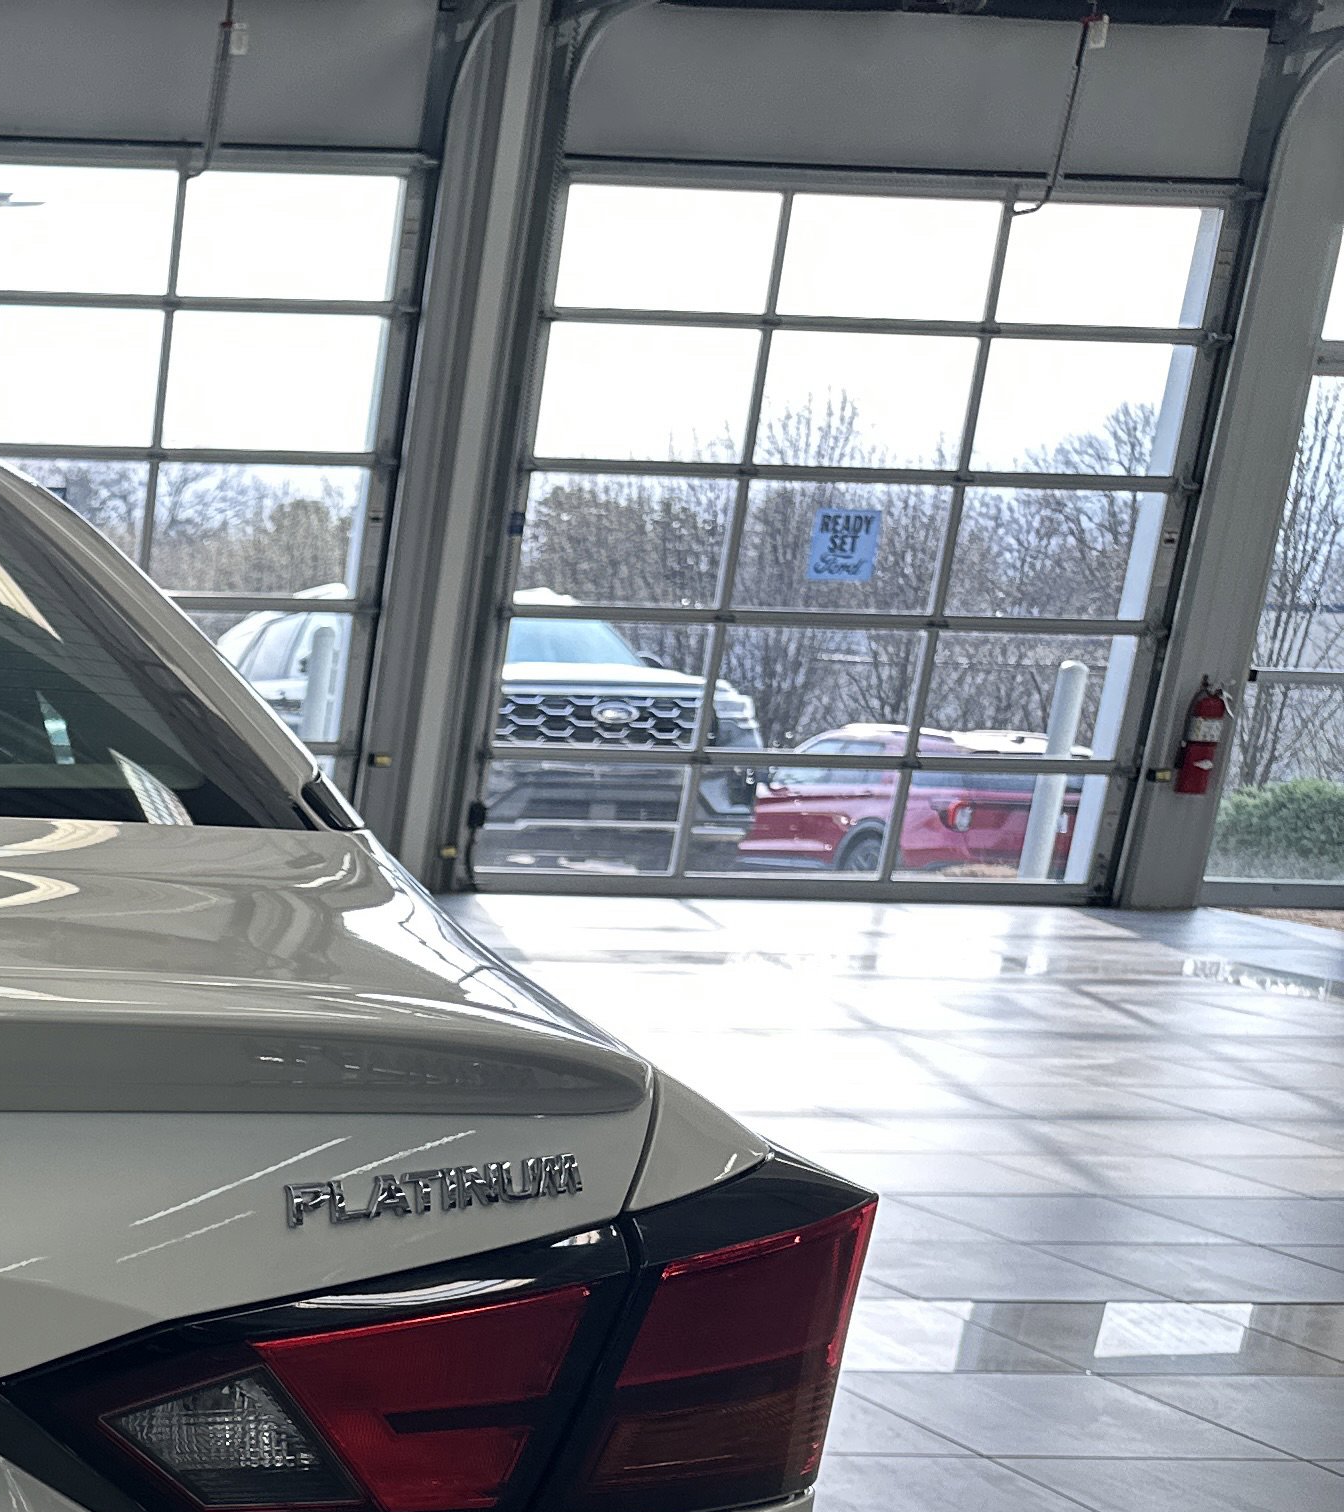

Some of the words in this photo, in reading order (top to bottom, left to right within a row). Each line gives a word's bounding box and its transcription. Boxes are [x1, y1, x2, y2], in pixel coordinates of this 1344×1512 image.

[821, 514, 876, 534] READY
[828, 534, 860, 552] SET
[814, 552, 867, 575] Ford
[283, 1152, 582, 1229] PLATINUM
